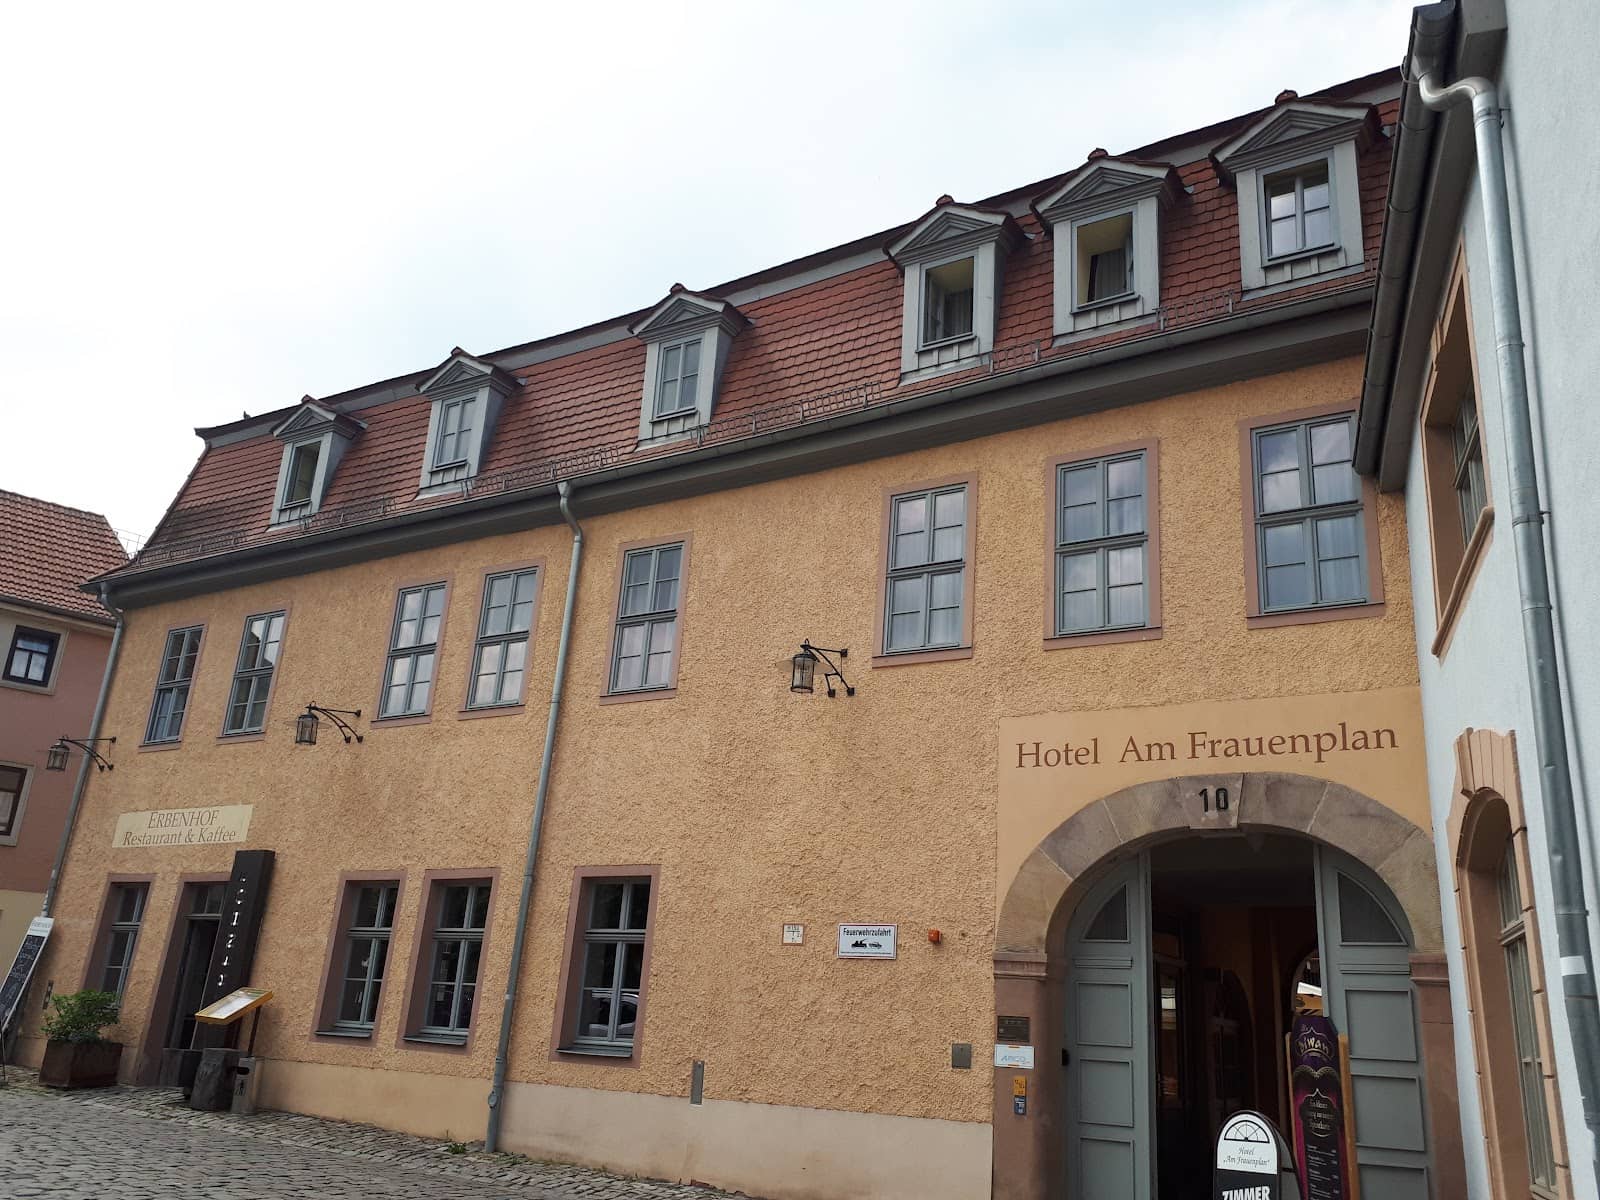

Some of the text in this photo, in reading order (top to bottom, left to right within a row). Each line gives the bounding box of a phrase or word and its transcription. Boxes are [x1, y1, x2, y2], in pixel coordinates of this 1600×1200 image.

[1016, 721, 1400, 769] Hotel Am Frauenplan
[1198, 787, 1230, 814] 10
[148, 809, 220, 829] ERBENHOF
[122, 826, 237, 847] Restaurant & Kaffee
[843, 926, 892, 938] Feuerwehrzufahrt
[1222, 1185, 1271, 1200] ZIMMER
